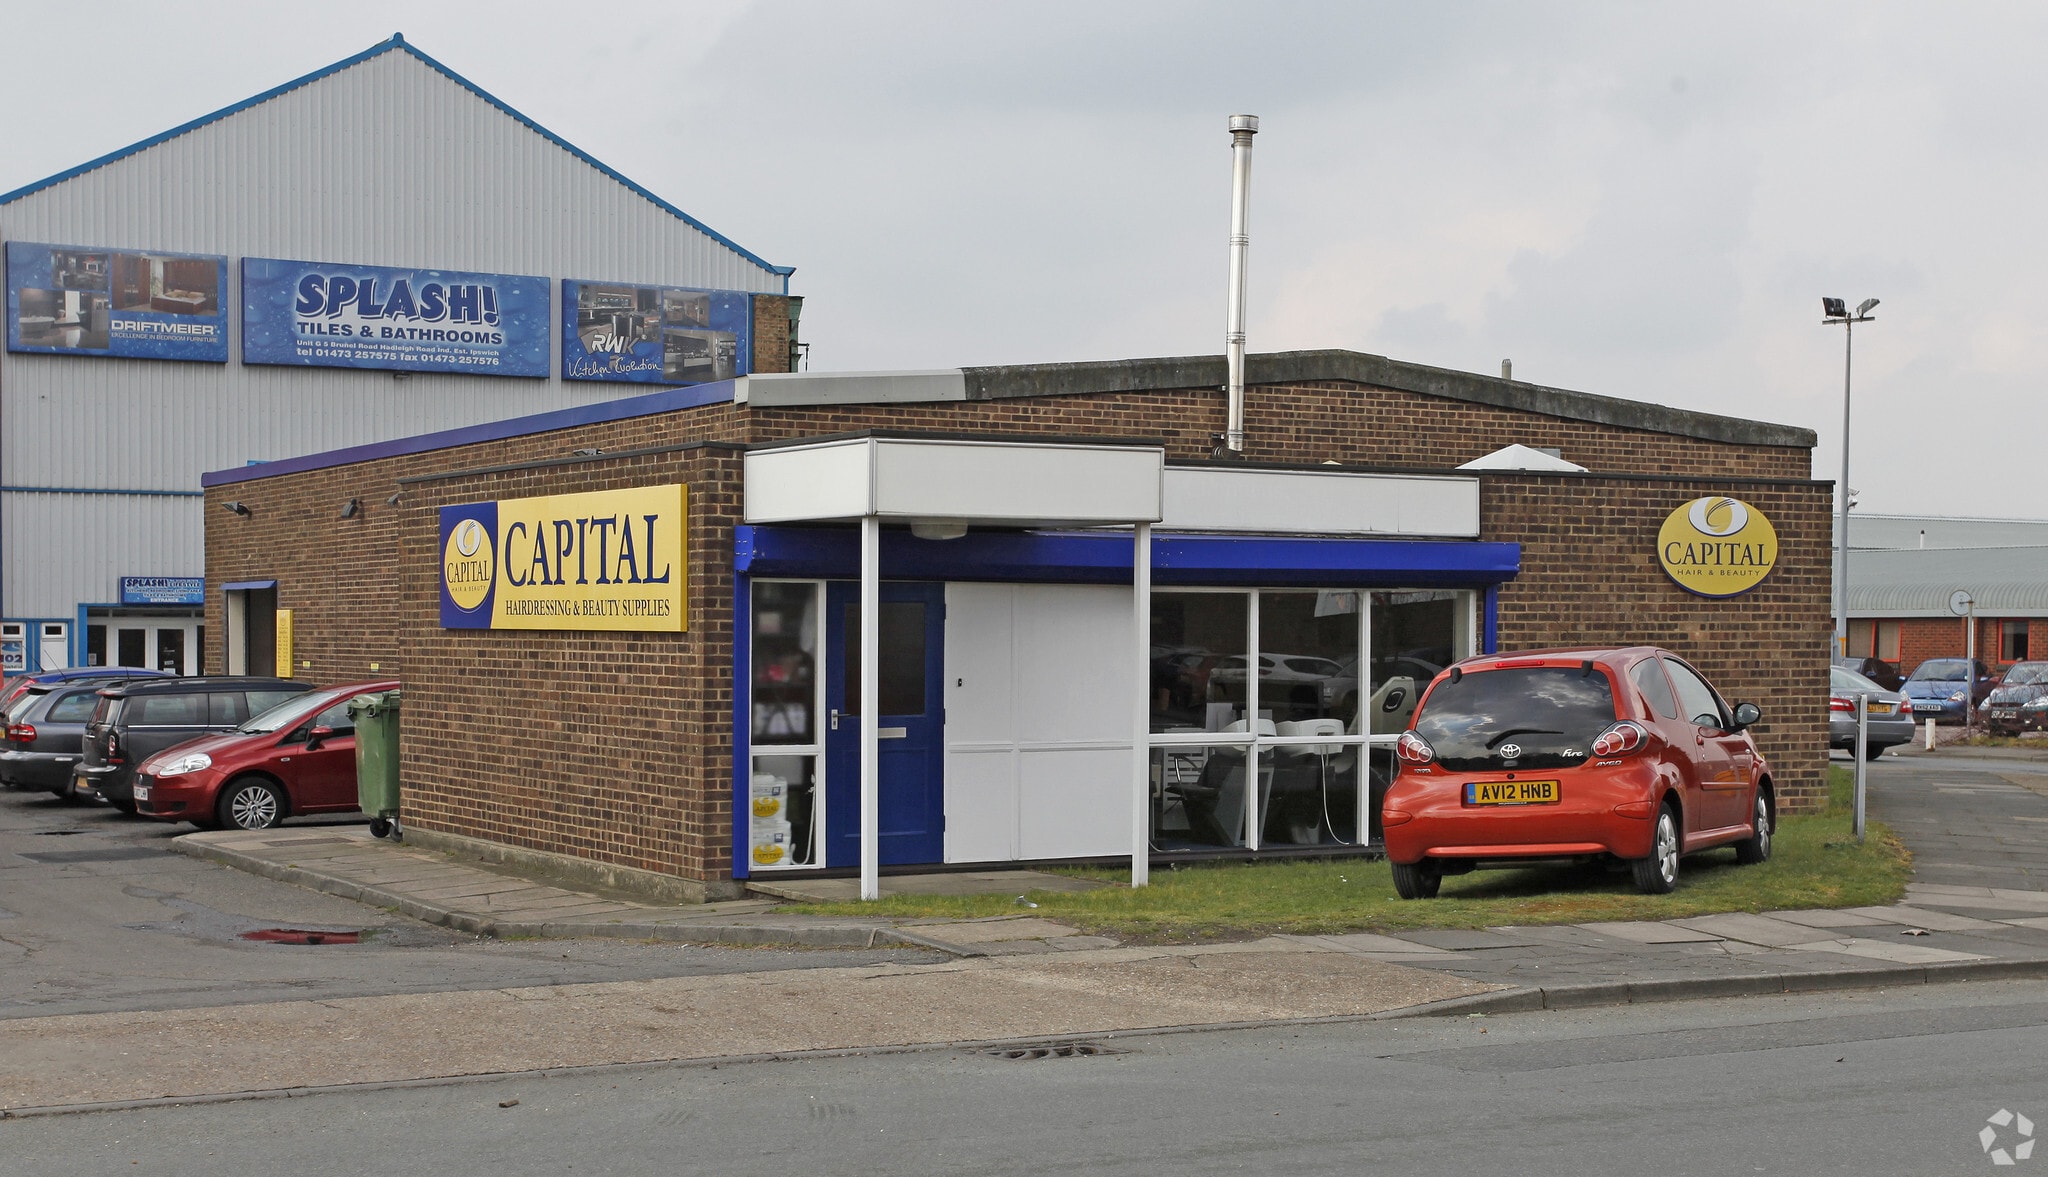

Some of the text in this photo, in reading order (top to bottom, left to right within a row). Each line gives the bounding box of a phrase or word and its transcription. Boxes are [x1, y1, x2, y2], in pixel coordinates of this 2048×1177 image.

[295, 273, 501, 327] SPLASH!
[111, 319, 214, 335] DRIFTMEIER
[297, 321, 503, 345] TILES & BATHROOMS
[296, 339, 313, 347] Unit
[330, 341, 356, 349] Brunel
[380, 344, 414, 353] Hadleigh
[416, 345, 436, 353] Road
[591, 332, 640, 355] RWK
[296, 347, 500, 365] tel 01473 257575 fax 01473 257576
[504, 513, 670, 588] CAPITAL
[1664, 541, 1771, 567] CAPITAL
[446, 560, 490, 583] CAPITAL
[1720, 569, 1761, 577] BEAUTY
[125, 578, 169, 588] SPLASH!
[505, 598, 671, 617] HAIRDRESSING & BEAUTY SUPPLIES
[1481, 783, 1552, 800] AV12 HNB
